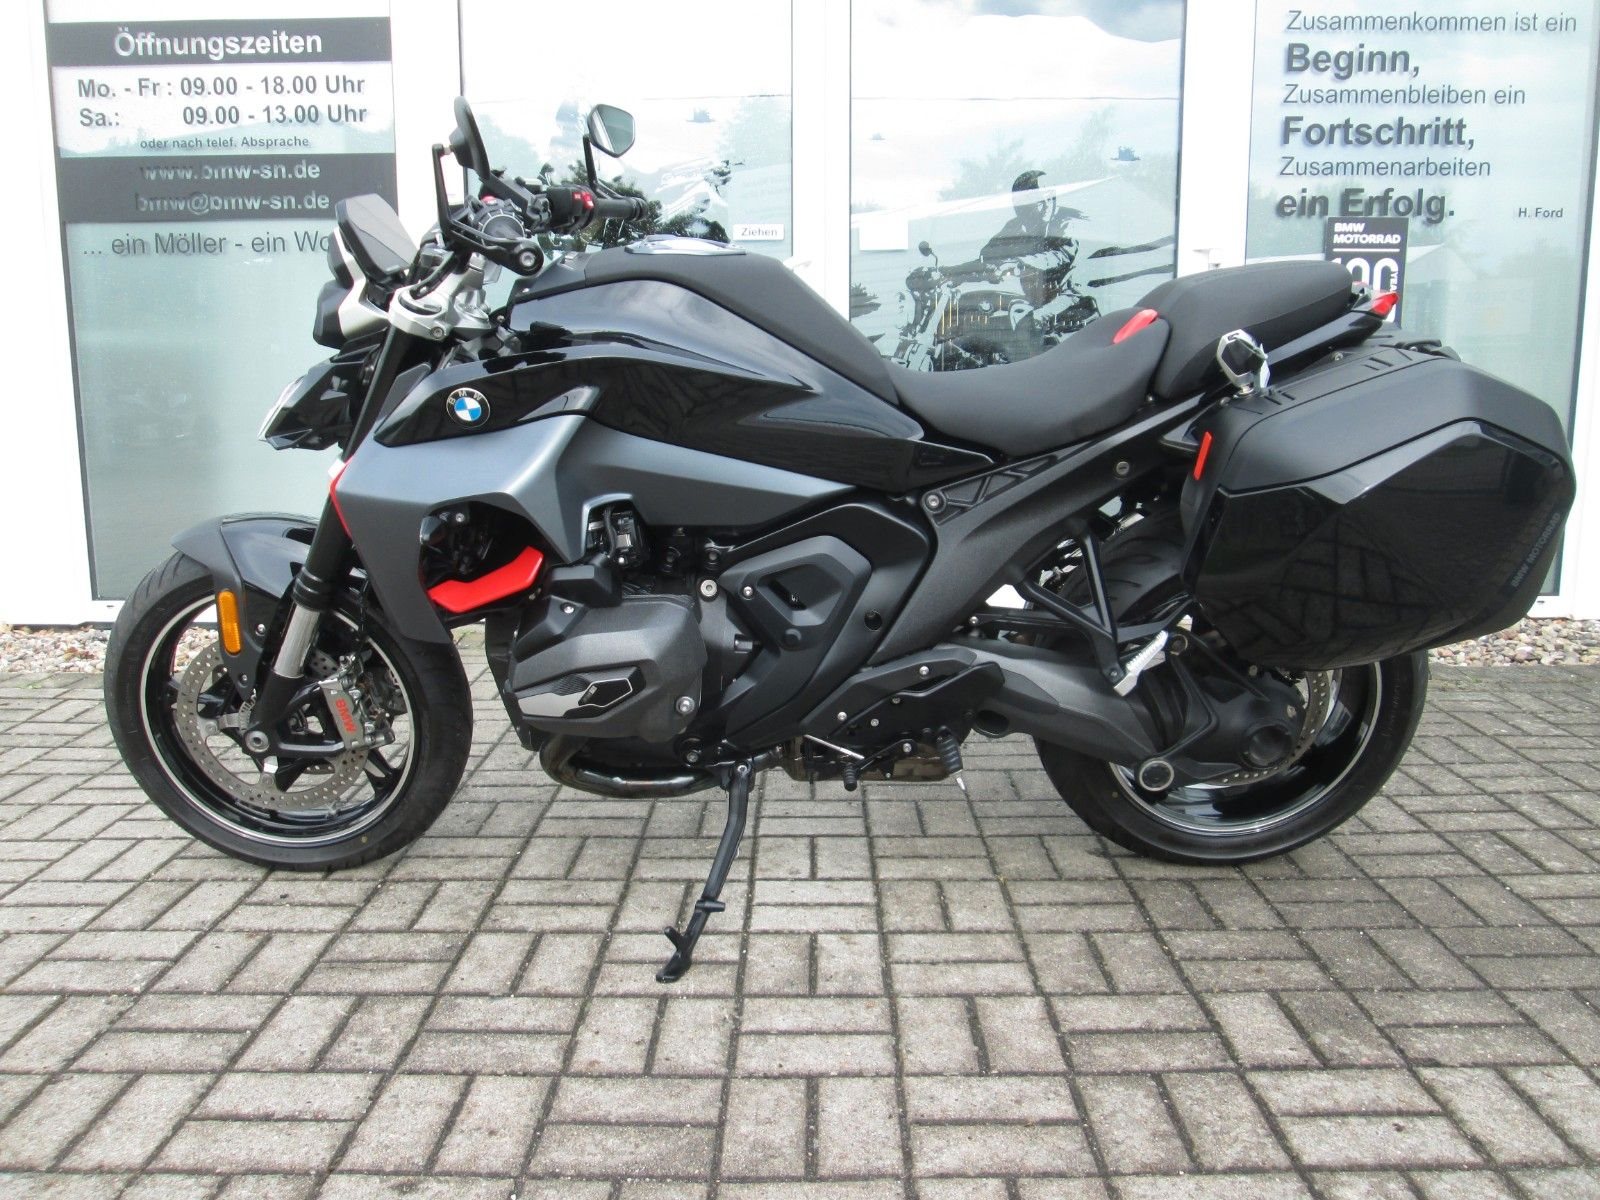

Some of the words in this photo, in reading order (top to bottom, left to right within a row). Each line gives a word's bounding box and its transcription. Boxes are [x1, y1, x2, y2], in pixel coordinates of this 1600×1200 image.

[1285, 10, 1506, 32] Zusammenkommen
[1514, 11, 1538, 32] ist
[1545, 12, 1577, 32] ein
[114, 26, 323, 60] Öffnungszeiten
[1286, 43, 1420, 80] Beginn,
[77, 79, 116, 98] Mo.
[180, 76, 238, 96] 09.00
[260, 75, 317, 95] 18.00
[325, 75, 366, 94] Uhr
[1283, 84, 1486, 104] Zusammenbleiben
[1494, 85, 1526, 104] ein
[79, 108, 120, 127] Sa.:
[183, 105, 240, 126] 09.00
[263, 104, 319, 124] 13.00
[328, 103, 367, 123] Uhr
[139, 138, 169, 149] oder
[172, 137, 203, 148] nach
[206, 137, 238, 148] telef.
[241, 136, 309, 149] Absprache
[1282, 115, 1475, 150] Fortschritt,
[139, 160, 321, 181] www.bmw-sn.de
[1279, 156, 1491, 177] Zusammenarbeiten
[134, 190, 330, 215] bmw@bmw-sn.de
[1276, 189, 1329, 217] ein
[1340, 188, 1455, 225] Erfolg.
[1518, 207, 1531, 218] H.
[1534, 206, 1563, 218] Ford
[741, 227, 778, 237] Ziehen
[1333, 234, 1401, 244] MOTORRAD
[1334, 223, 1366, 233] BMW
[111, 233, 146, 253] ein
[155, 232, 226, 254] Möller
[251, 232, 286, 252] ein
[294, 230, 329, 253] Wo
[448, 390, 483, 405] BMW
[1511, 563, 1529, 587] BMW
[1526, 512, 1560, 563] MOTORRAD
[336, 699, 357, 732] BMW
